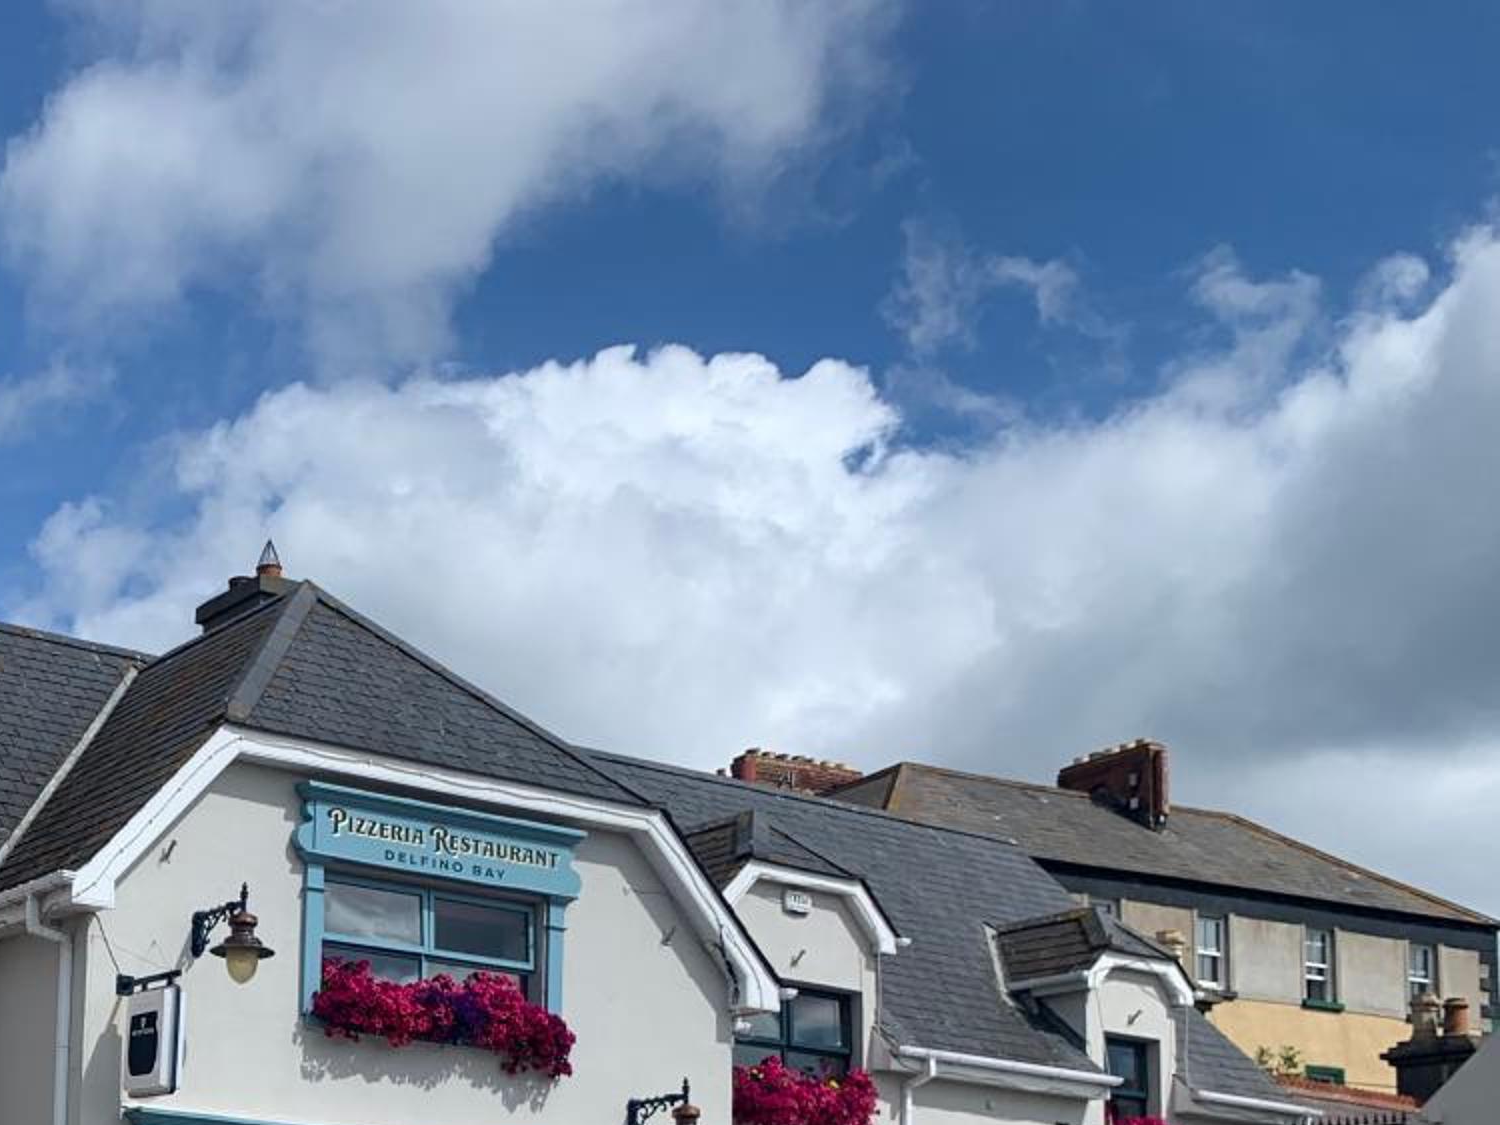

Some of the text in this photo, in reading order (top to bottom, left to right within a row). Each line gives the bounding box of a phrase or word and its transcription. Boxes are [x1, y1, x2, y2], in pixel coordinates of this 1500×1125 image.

[328, 807, 560, 869] PIZZERIA RESTAURANT
[385, 849, 506, 880] DELFINO BAY
